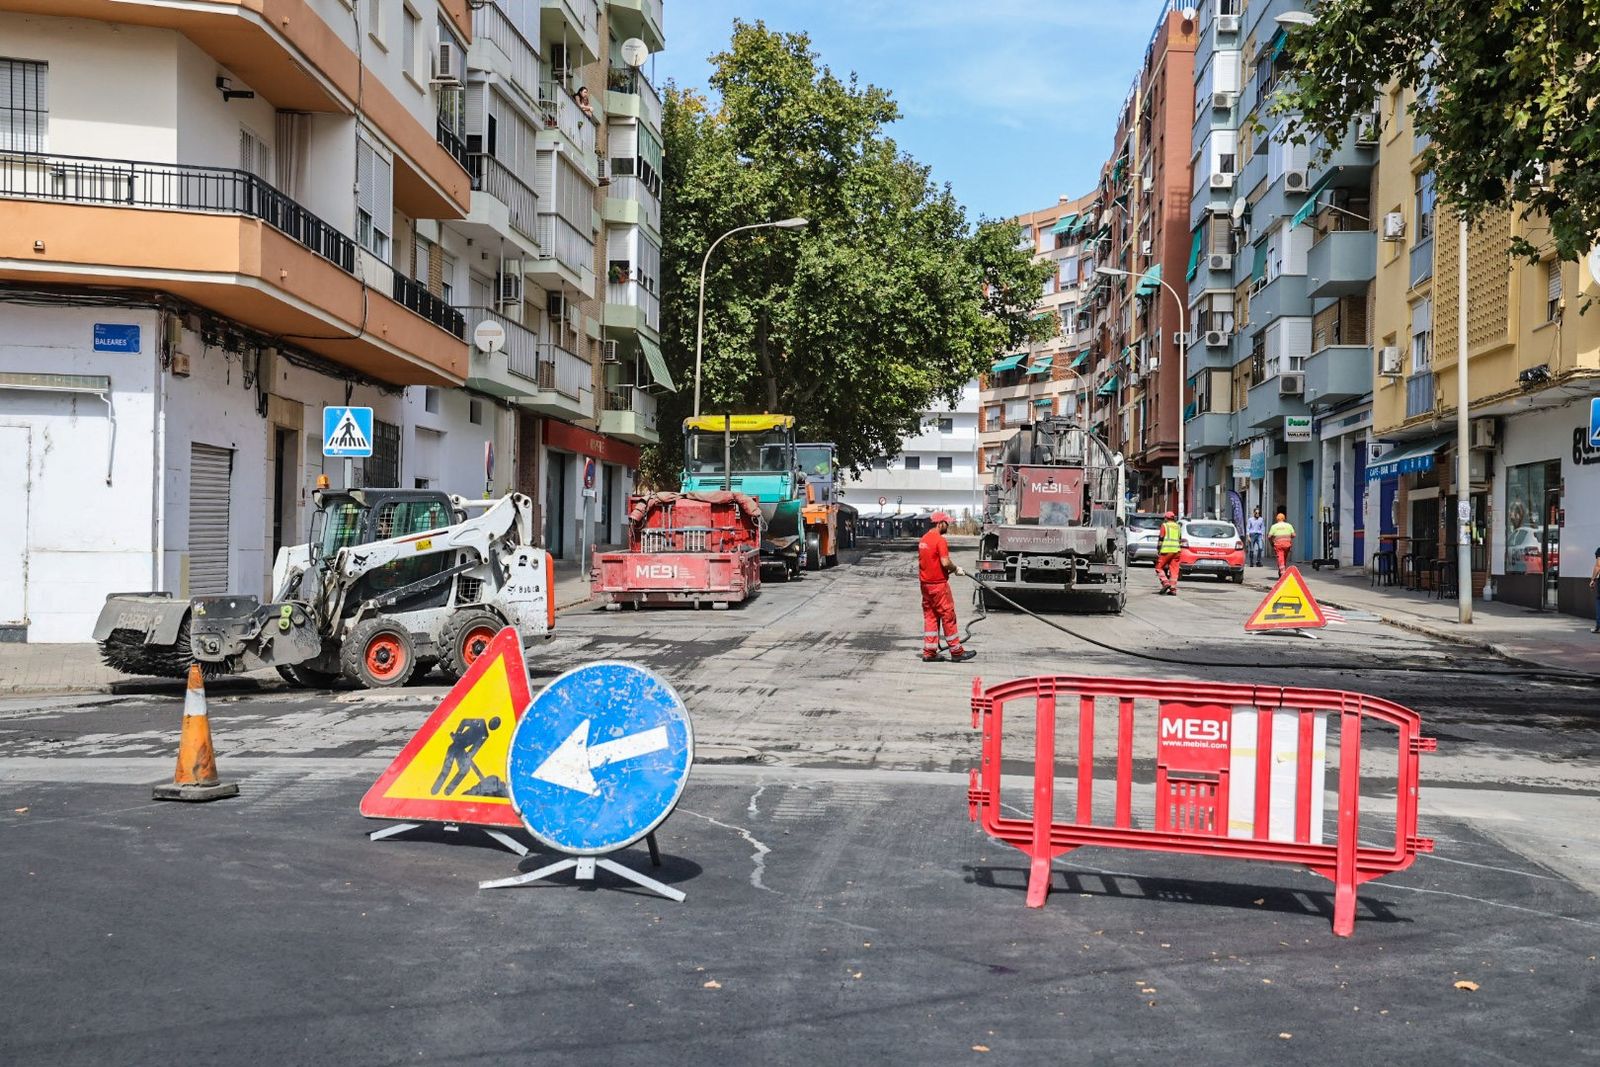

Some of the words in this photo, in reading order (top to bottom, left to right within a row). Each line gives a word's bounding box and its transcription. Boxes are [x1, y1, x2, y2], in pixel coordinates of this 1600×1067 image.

[95, 338, 127, 346] BALEARES
[1031, 482, 1062, 493] MEBI
[518, 555, 528, 567] 2
[636, 564, 678, 579] MEBI
[1162, 717, 1228, 741] MEBI
[1162, 740, 1228, 749] www.mebisl.com
